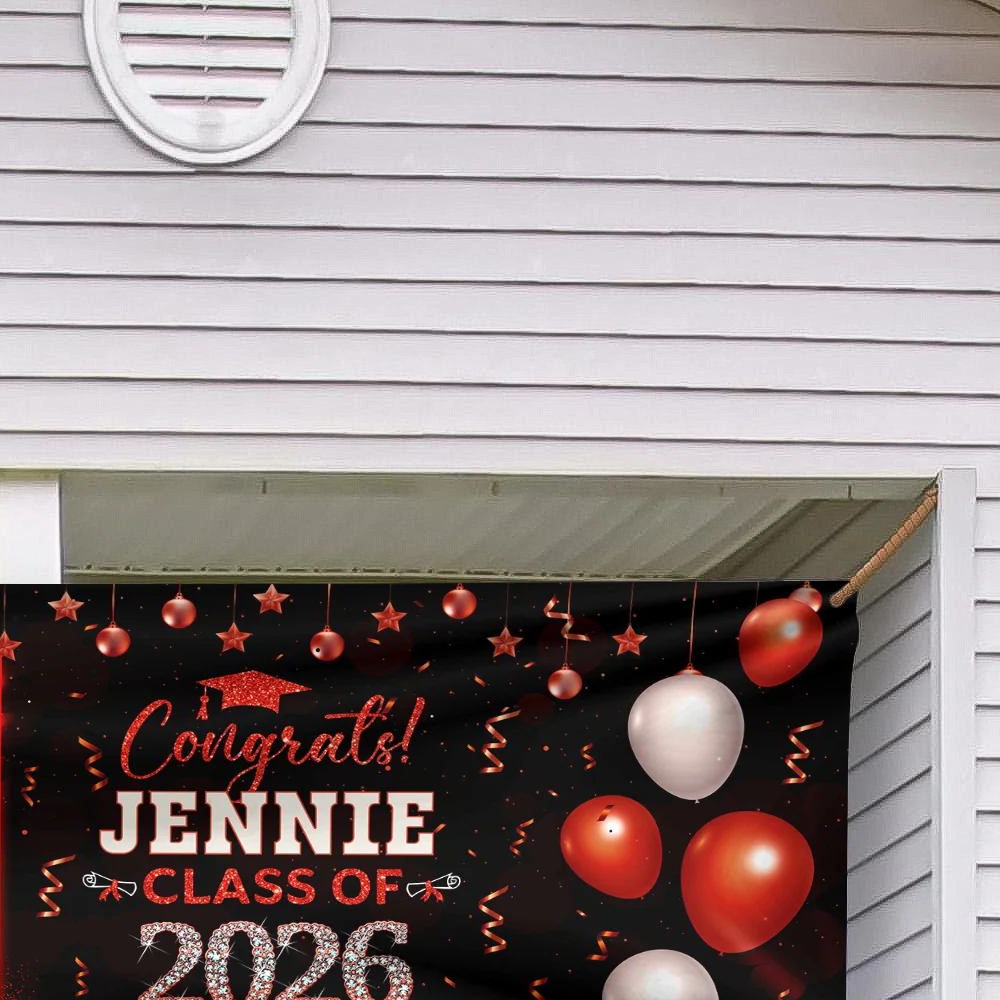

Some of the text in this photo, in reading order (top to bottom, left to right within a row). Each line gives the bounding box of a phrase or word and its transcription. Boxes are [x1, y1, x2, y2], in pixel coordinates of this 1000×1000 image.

[120, 694, 426, 803] Congrats!
[99, 790, 435, 856] JENNIE
[142, 867, 404, 905] CLASS OF
